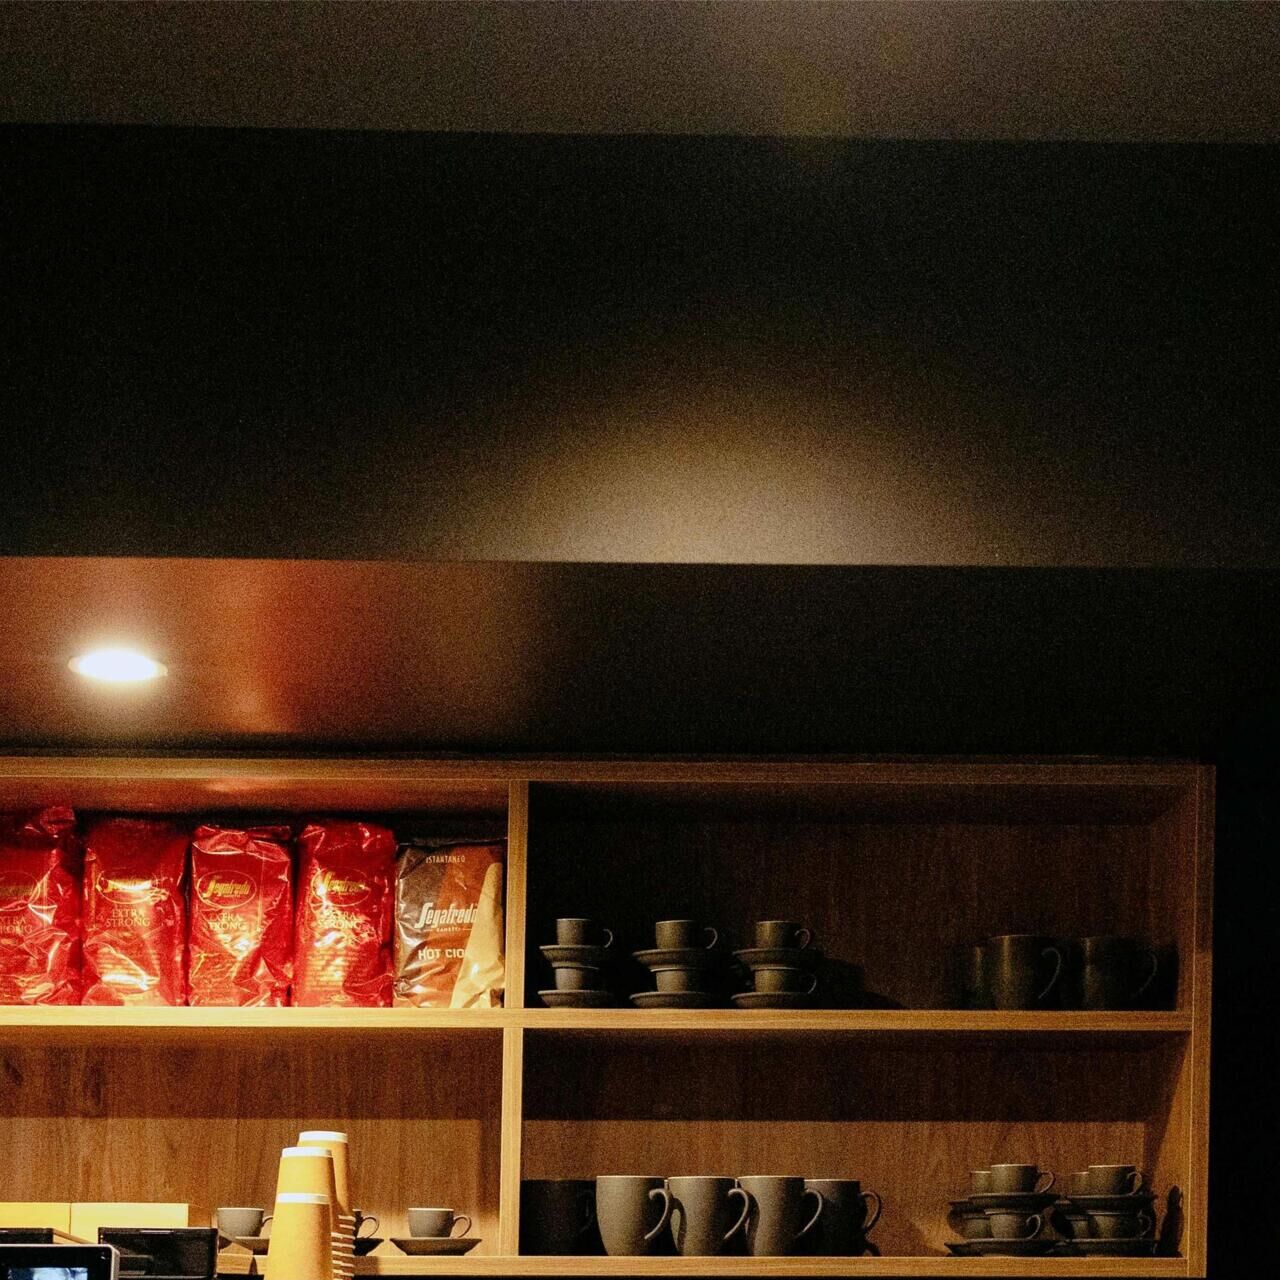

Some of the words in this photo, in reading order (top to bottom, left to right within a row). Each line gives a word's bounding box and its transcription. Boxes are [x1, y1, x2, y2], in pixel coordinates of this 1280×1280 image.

[112, 908, 146, 919] EXTRA
[106, 917, 151, 928] STRONG
[418, 949, 440, 961] HOT
[445, 949, 466, 959] CIO
